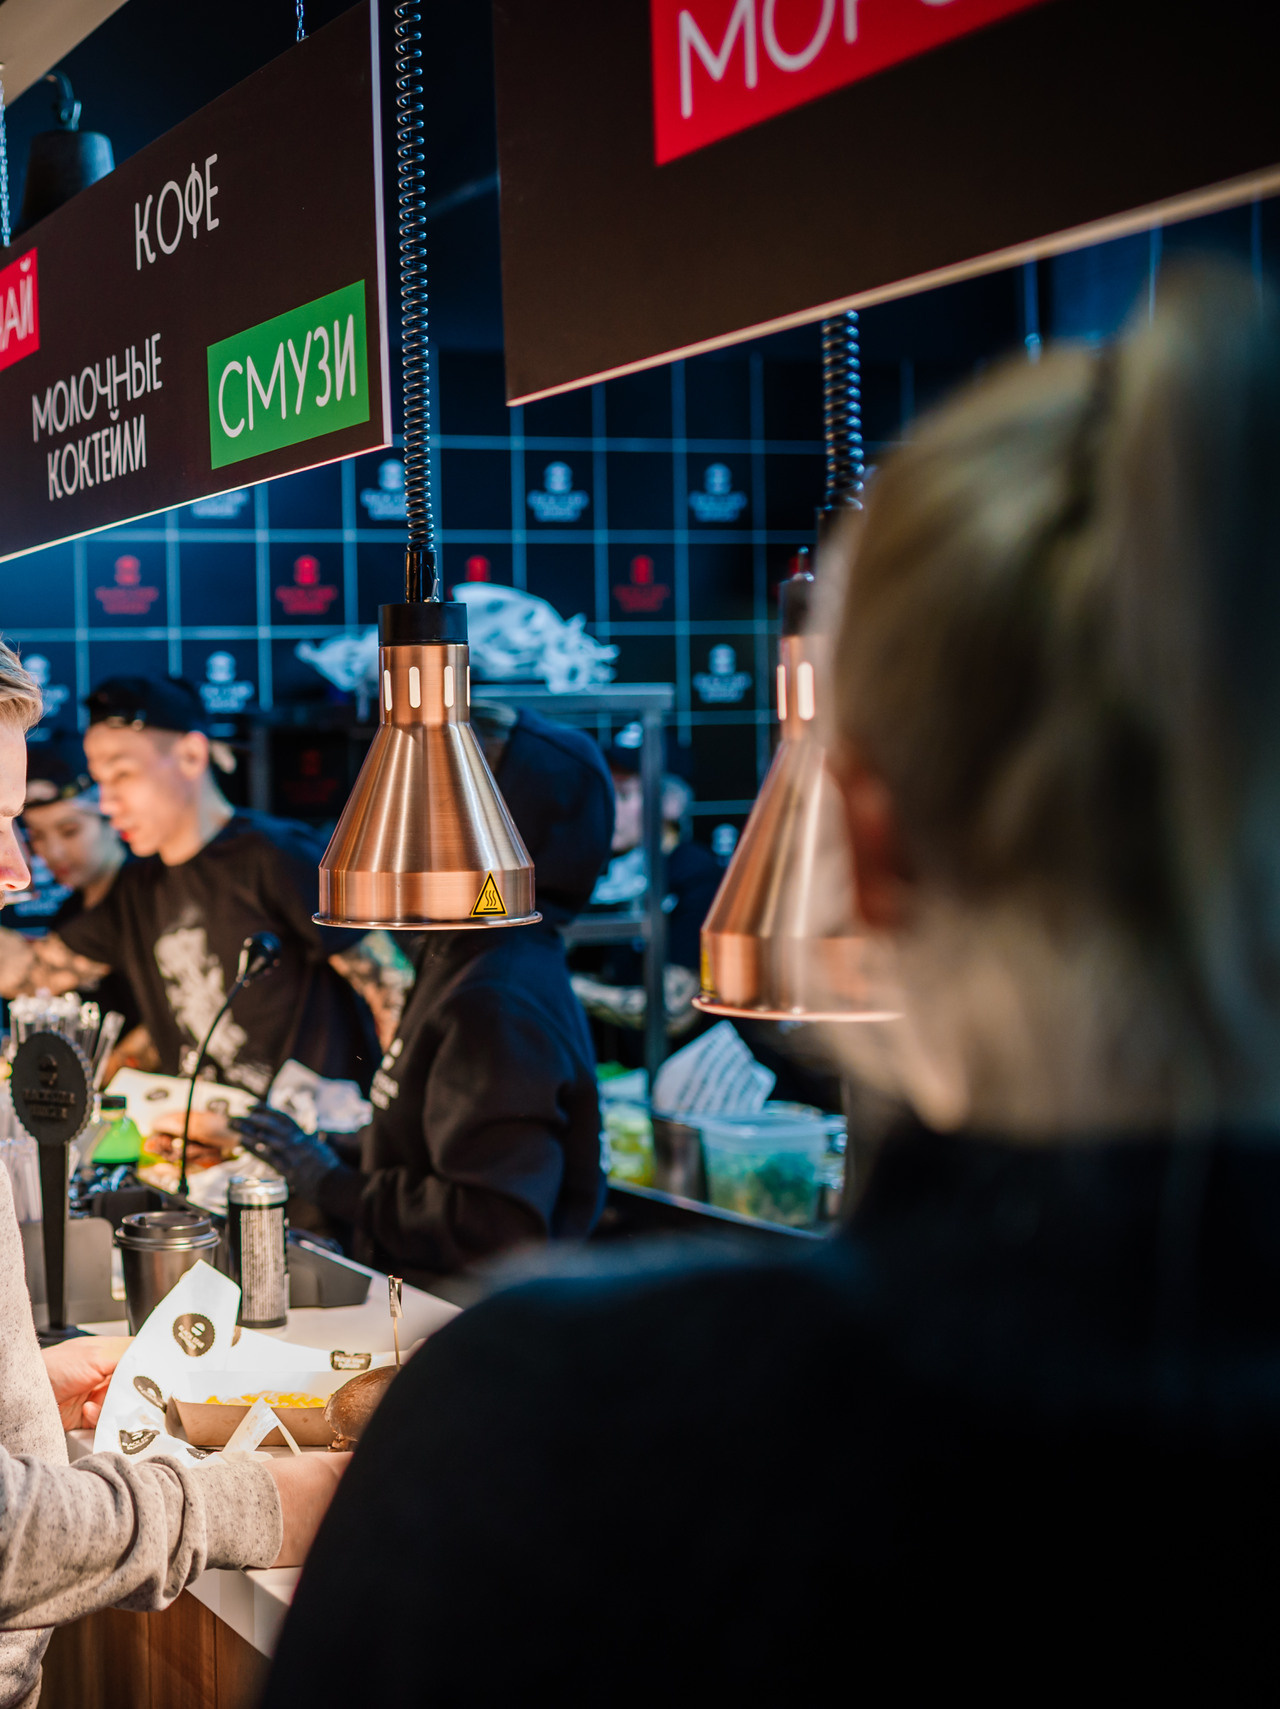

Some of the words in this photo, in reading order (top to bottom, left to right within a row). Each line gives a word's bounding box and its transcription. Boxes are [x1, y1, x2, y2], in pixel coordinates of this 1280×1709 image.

[134, 153, 220, 270] КОФЕ
[31, 333, 163, 442] МОЛОЧНЫЕ
[218, 314, 357, 438] СМУЗИ
[48, 408, 147, 501] КОКТЕЙЛИ
